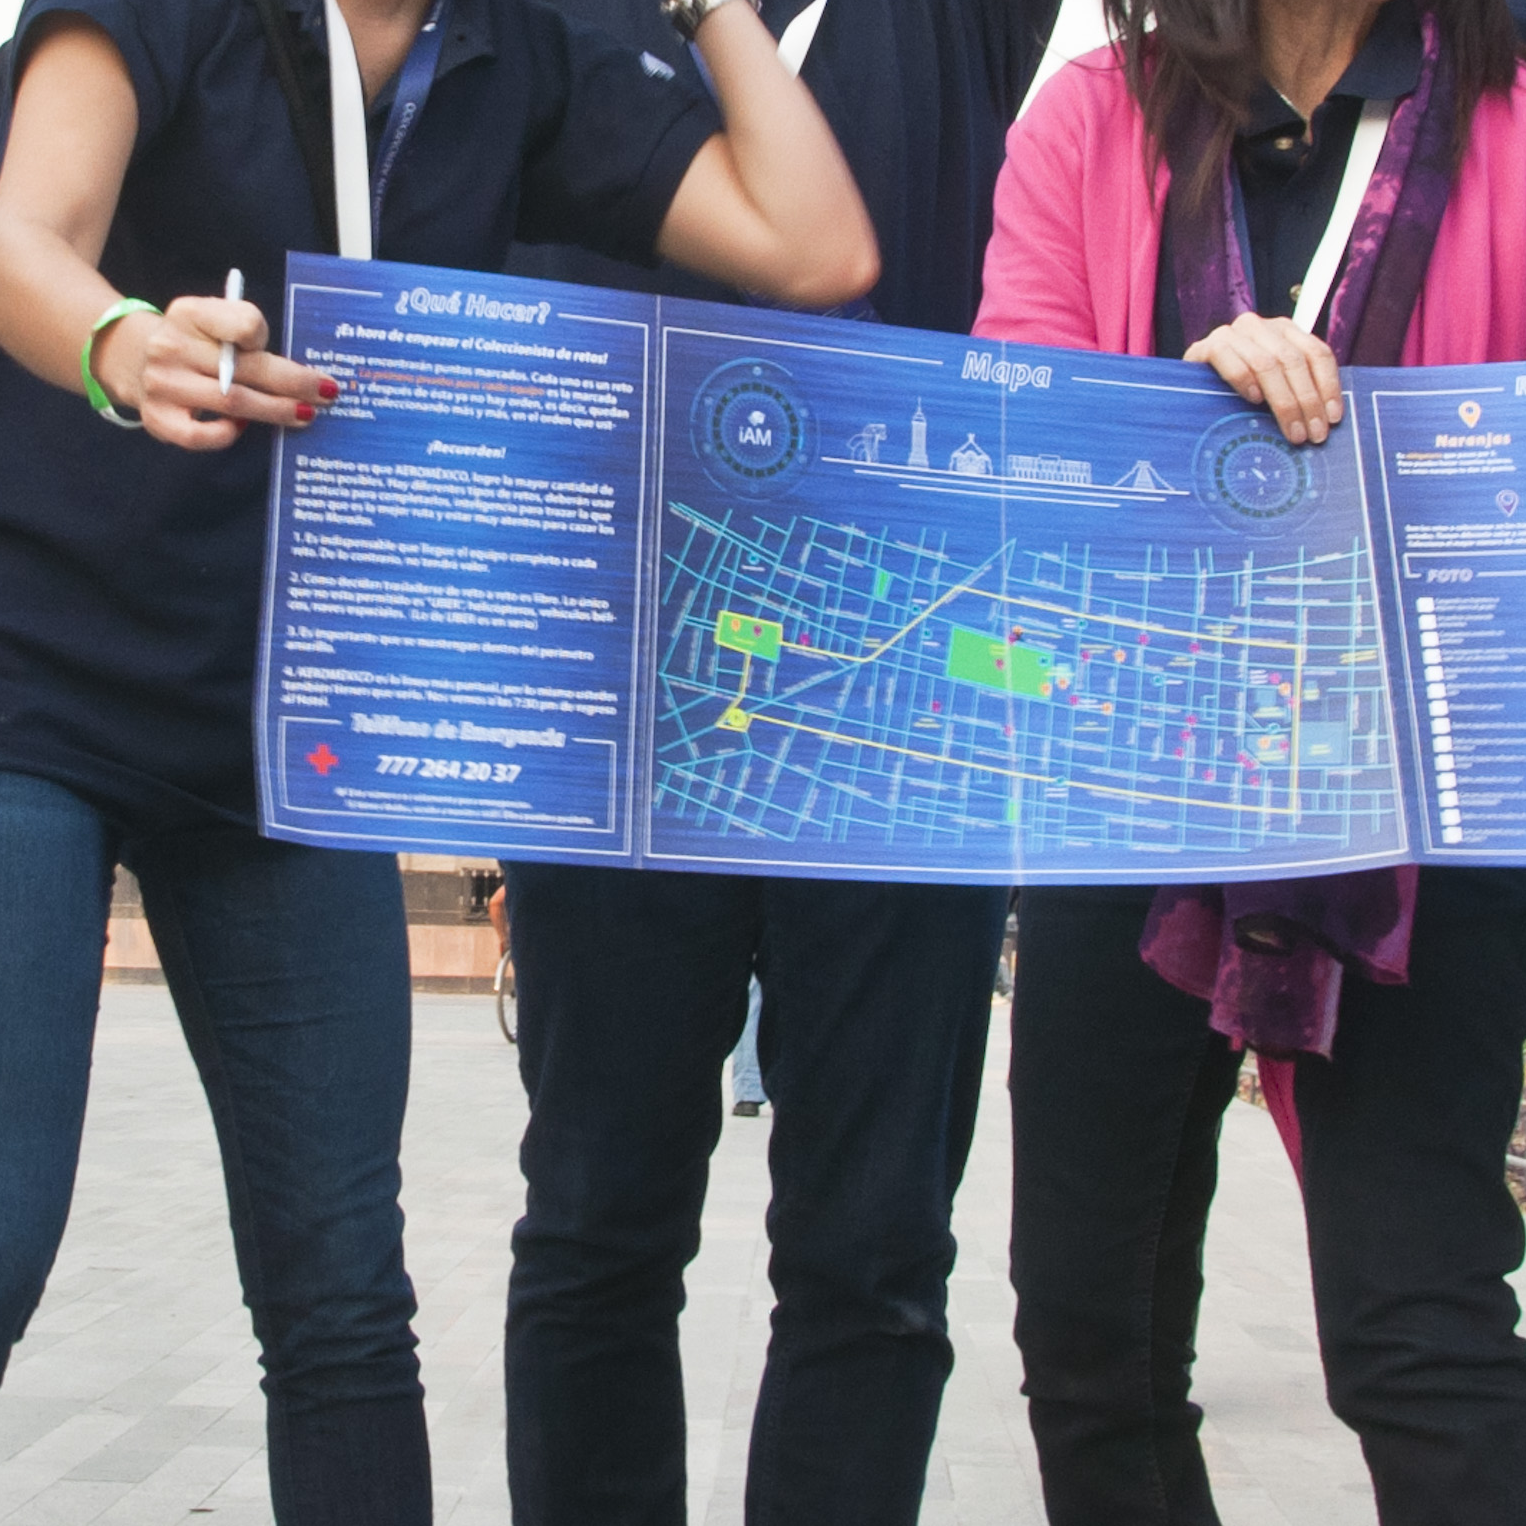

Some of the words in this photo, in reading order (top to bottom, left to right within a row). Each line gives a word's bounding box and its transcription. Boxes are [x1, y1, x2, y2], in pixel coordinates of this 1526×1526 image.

[395, 287, 462, 315] ¿Qué
[465, 293, 551, 325] Hacer?
[355, 325, 387, 340] hora
[387, 328, 404, 342] de
[461, 337, 474, 349] el
[555, 347, 572, 360] de
[961, 350, 1053, 392] Mapa
[738, 426, 772, 447] iAM
[1435, 431, 1512, 449] Naranjas
[1425, 568, 1474, 583] FOTO
[375, 754, 419, 776] 777
[418, 758, 461, 779] 264
[460, 761, 491, 781] 20
[491, 763, 522, 782] 37
